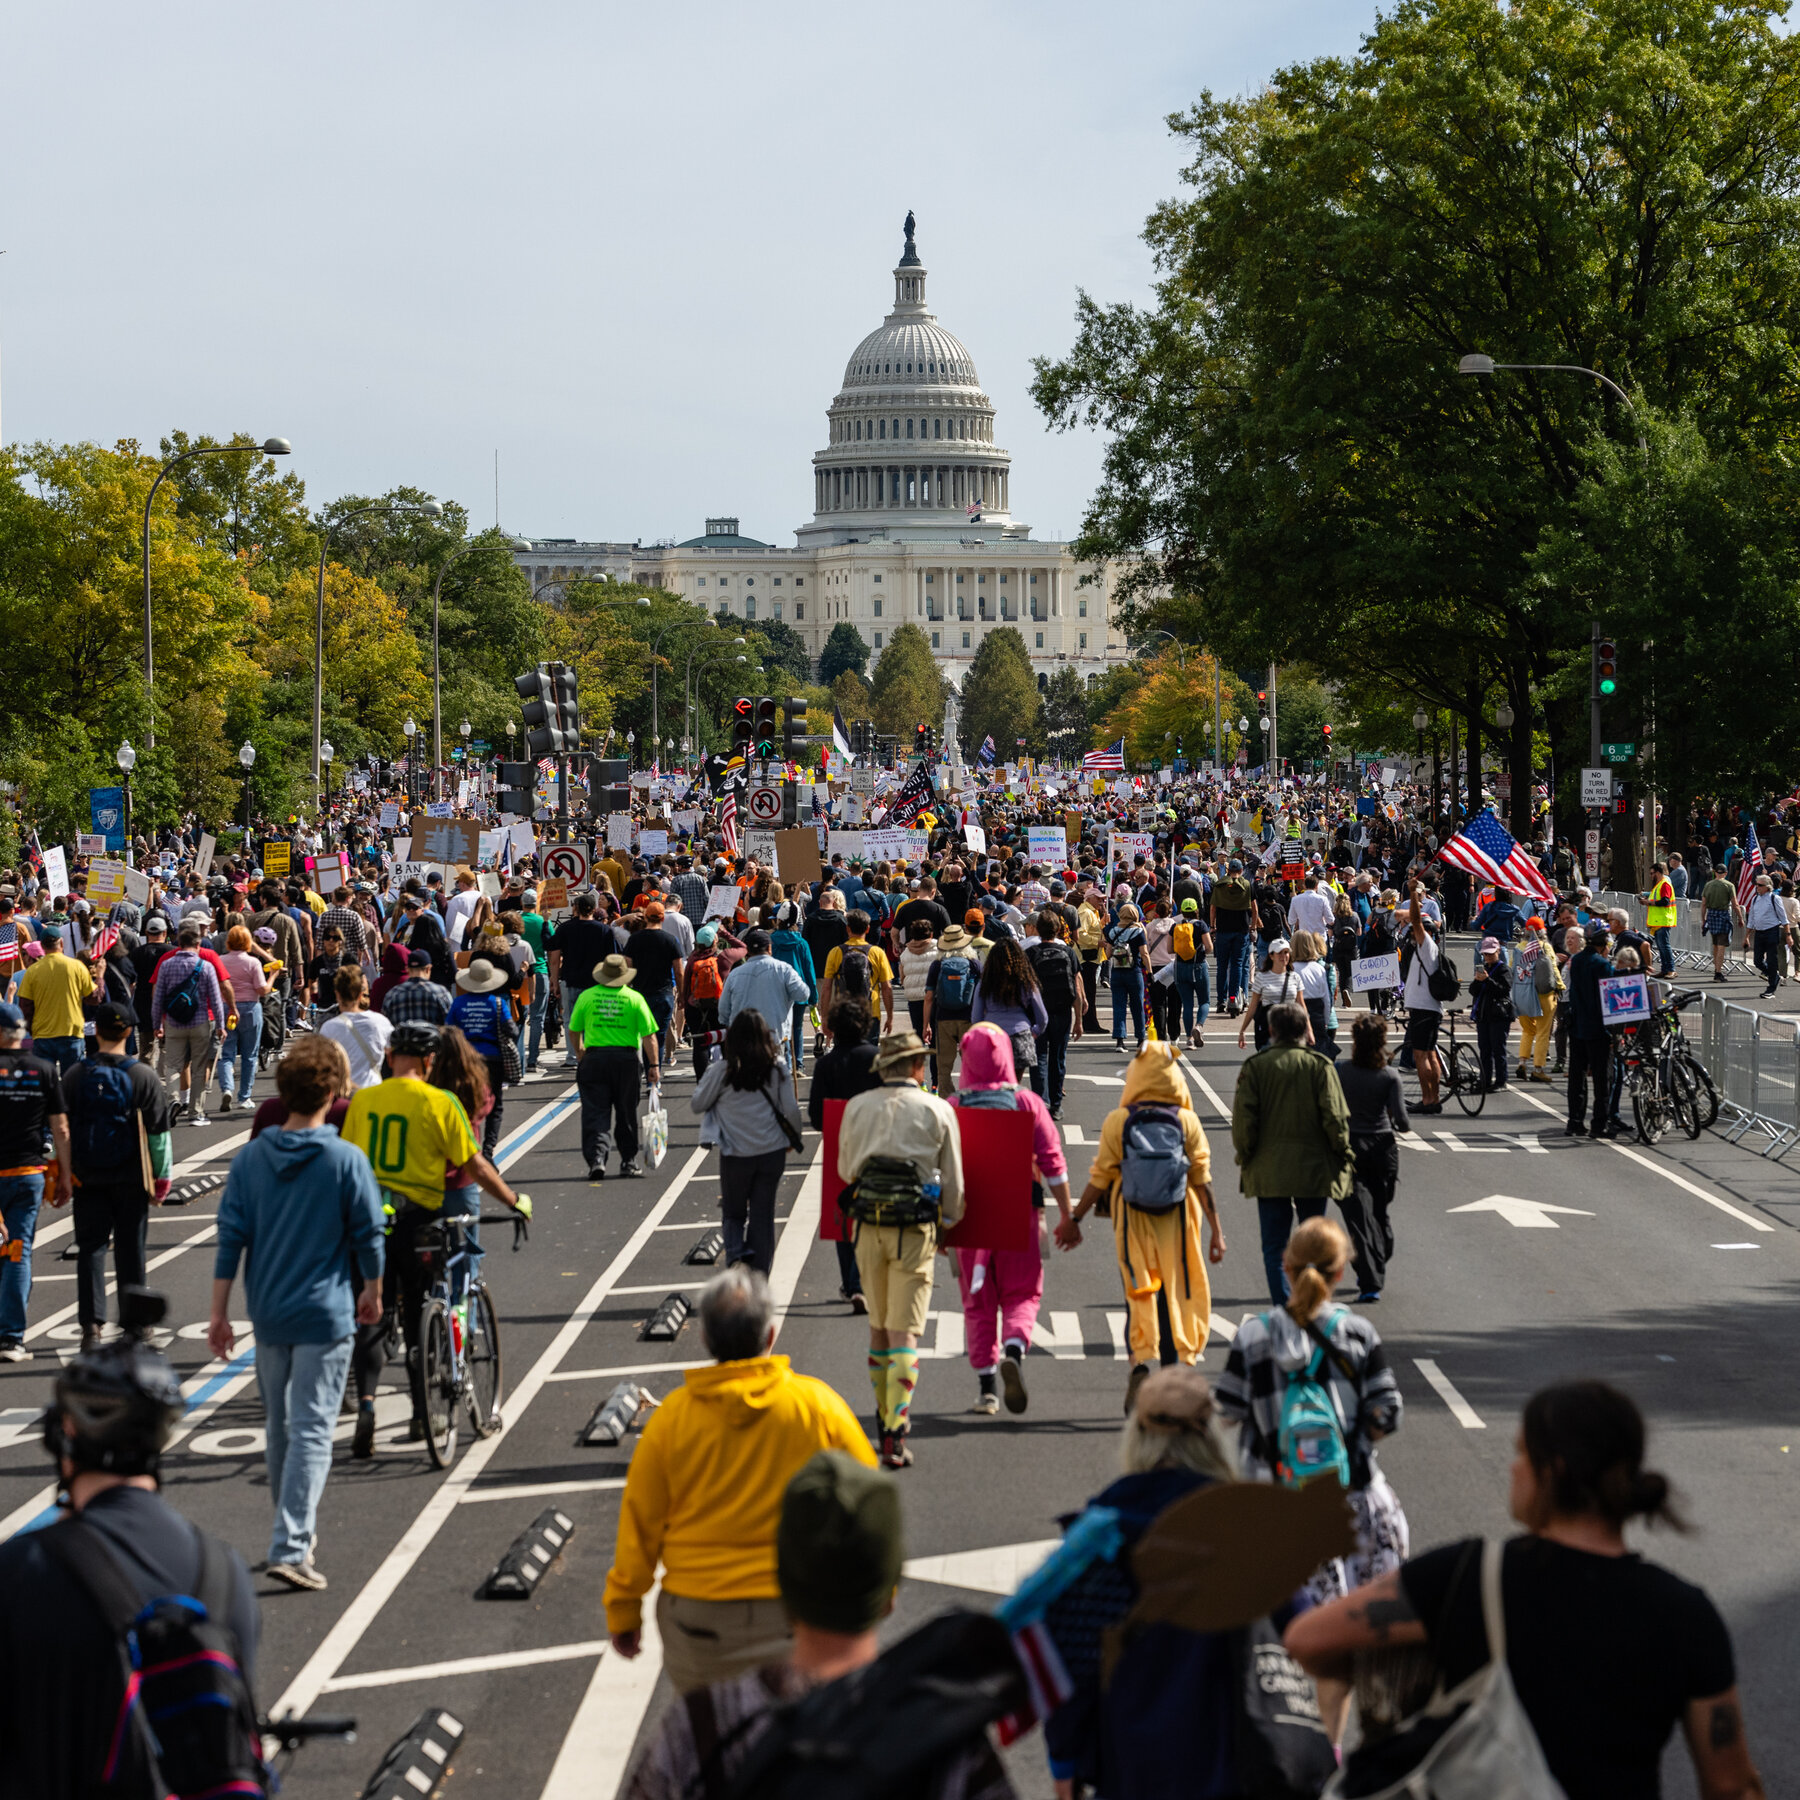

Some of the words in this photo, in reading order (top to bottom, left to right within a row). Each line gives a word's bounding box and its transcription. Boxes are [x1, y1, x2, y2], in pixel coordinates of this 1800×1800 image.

[1608, 745, 1616, 755] 6
[1588, 780, 1605, 788] TURN
[1617, 799, 1626, 813] 33
[753, 835, 775, 843] TURNIN
[395, 863, 422, 875] BAN
[1359, 956, 1389, 970] GOOD
[1352, 971, 1385, 987] TROUBLE
[368, 1110, 408, 1173] 10
[1395, 1130, 1550, 1154] NLY
